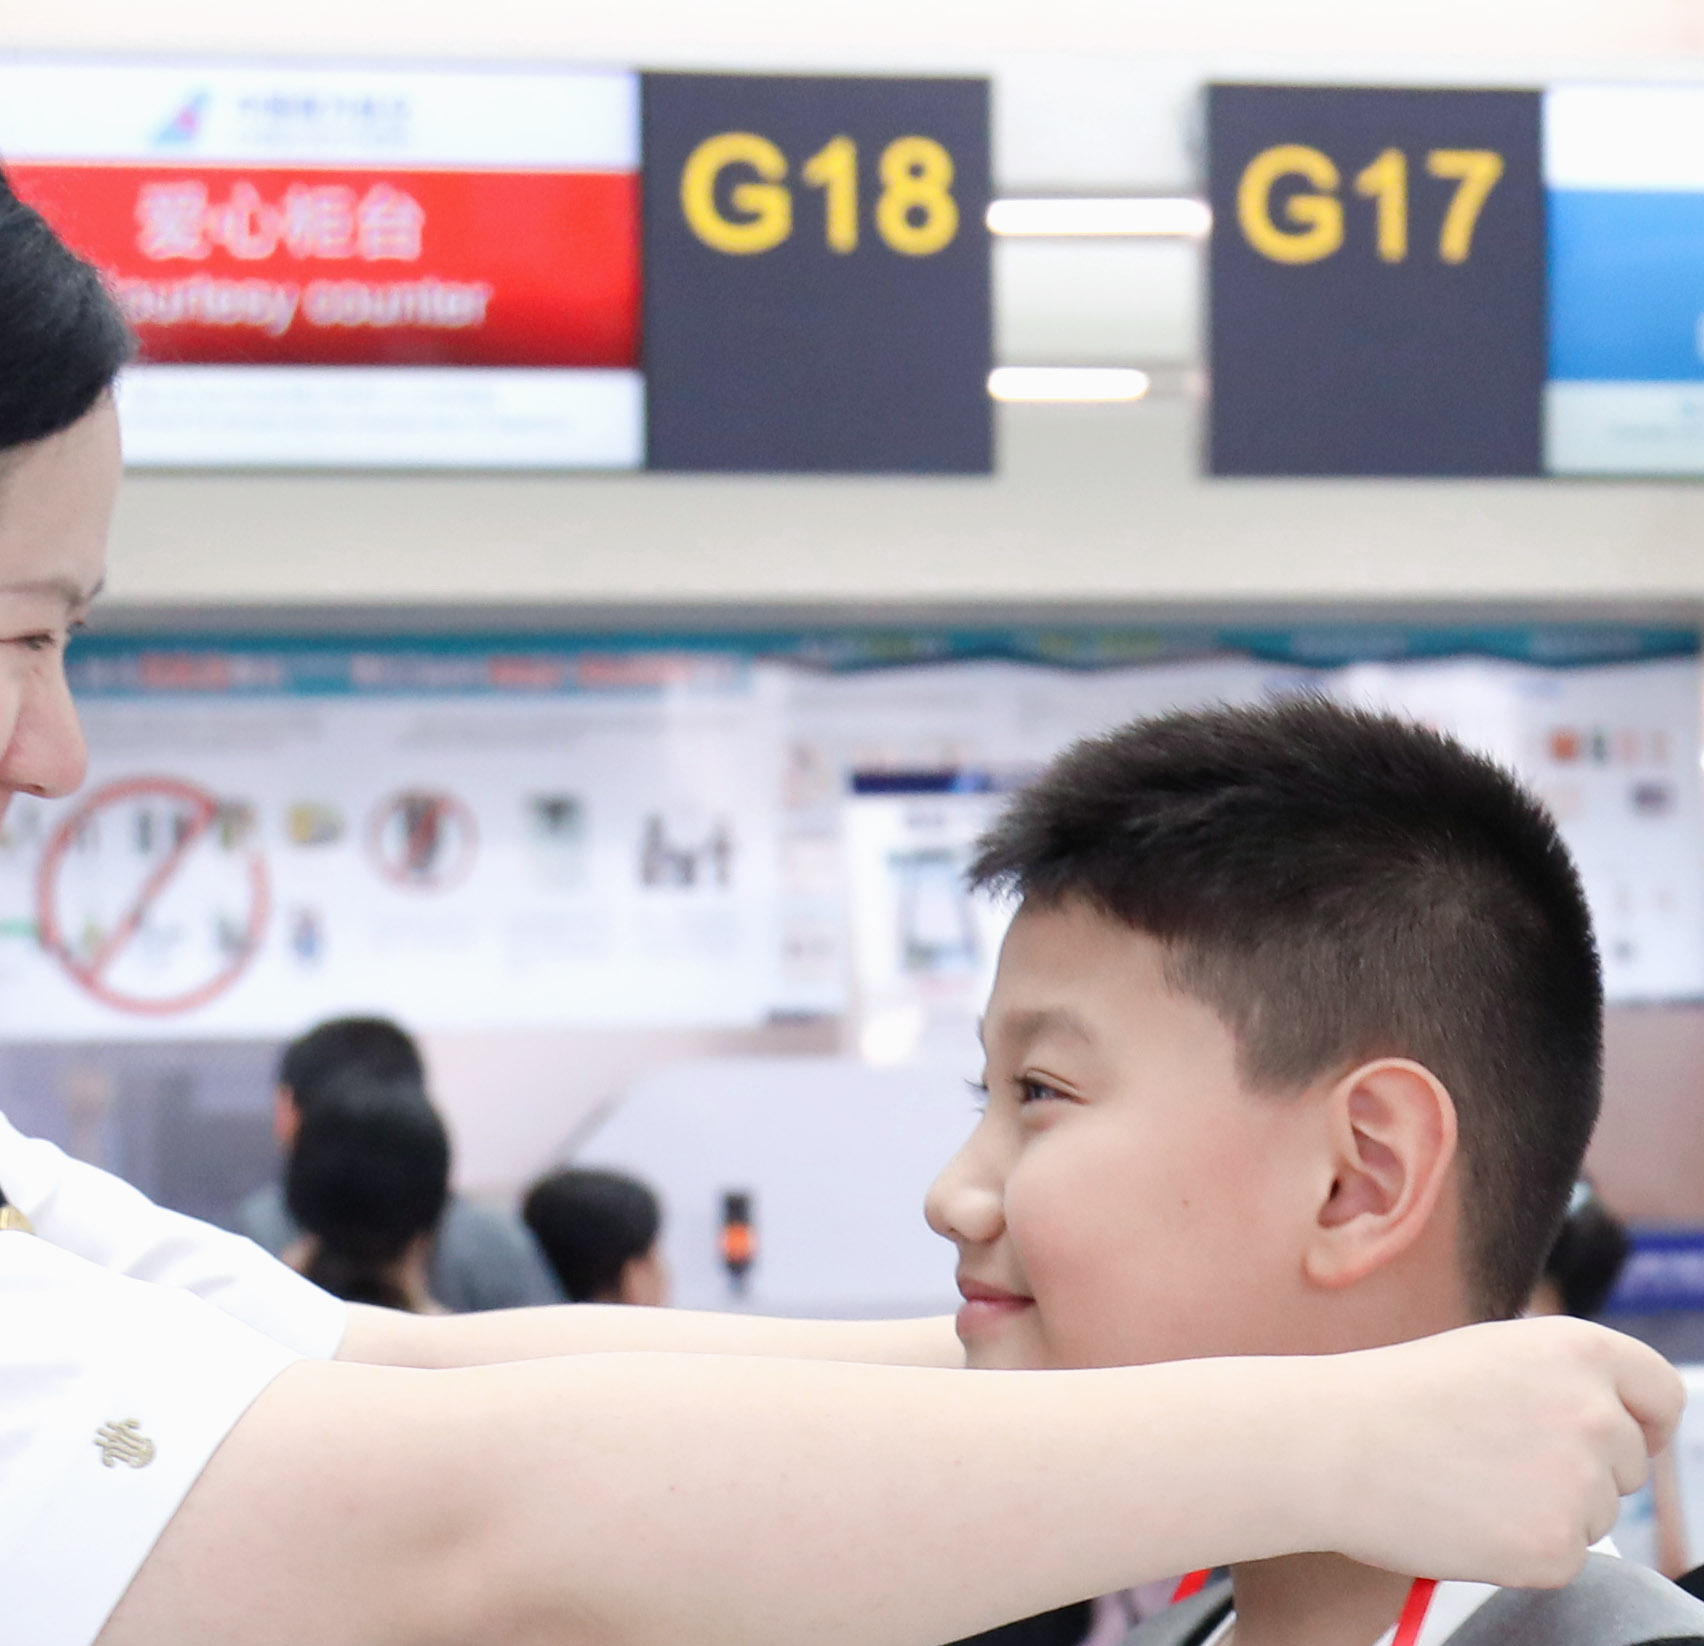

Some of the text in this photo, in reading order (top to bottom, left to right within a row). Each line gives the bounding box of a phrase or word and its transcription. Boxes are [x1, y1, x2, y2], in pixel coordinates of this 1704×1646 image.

[135, 178, 426, 262] 爱心柜台
[680, 130, 960, 257] G18
[1236, 143, 1506, 266] G17
[122, 275, 492, 338] ourtesy counter
